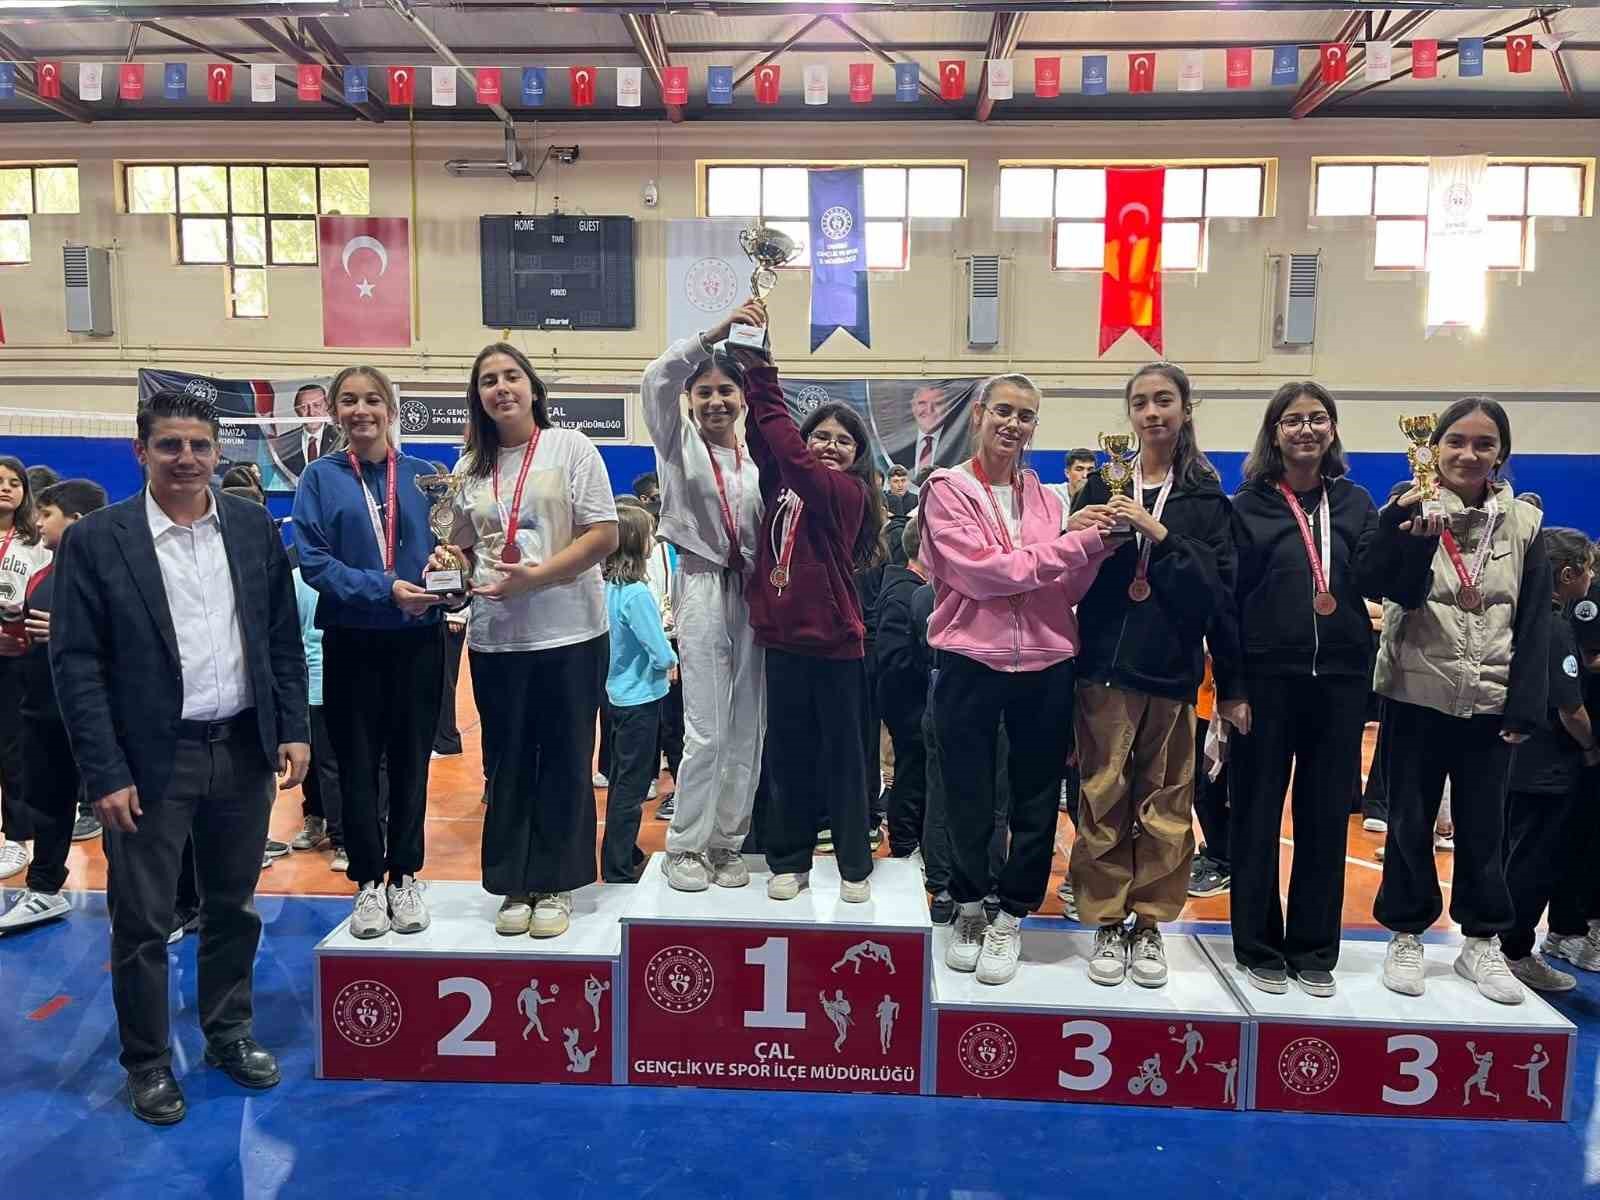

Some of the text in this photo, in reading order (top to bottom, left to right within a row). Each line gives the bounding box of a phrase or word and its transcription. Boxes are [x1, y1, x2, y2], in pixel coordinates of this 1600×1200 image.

[514, 220, 535, 231] HOME
[579, 220, 600, 232] GUEST
[551, 235, 564, 243] TIME
[550, 288, 567, 296] PERIOD
[431, 408, 446, 416] T.C.
[2, 554, 28, 575] eles
[744, 936, 806, 1029] 1
[437, 976, 496, 1056] 2
[754, 1042, 795, 1063] ÇAL
[1058, 1019, 1112, 1091] 3
[634, 1059, 915, 1082] GENÇLİK VE SPOR İLÇE MÜDÜRLÜĞÜ
[1382, 1034, 1439, 1106] 3
